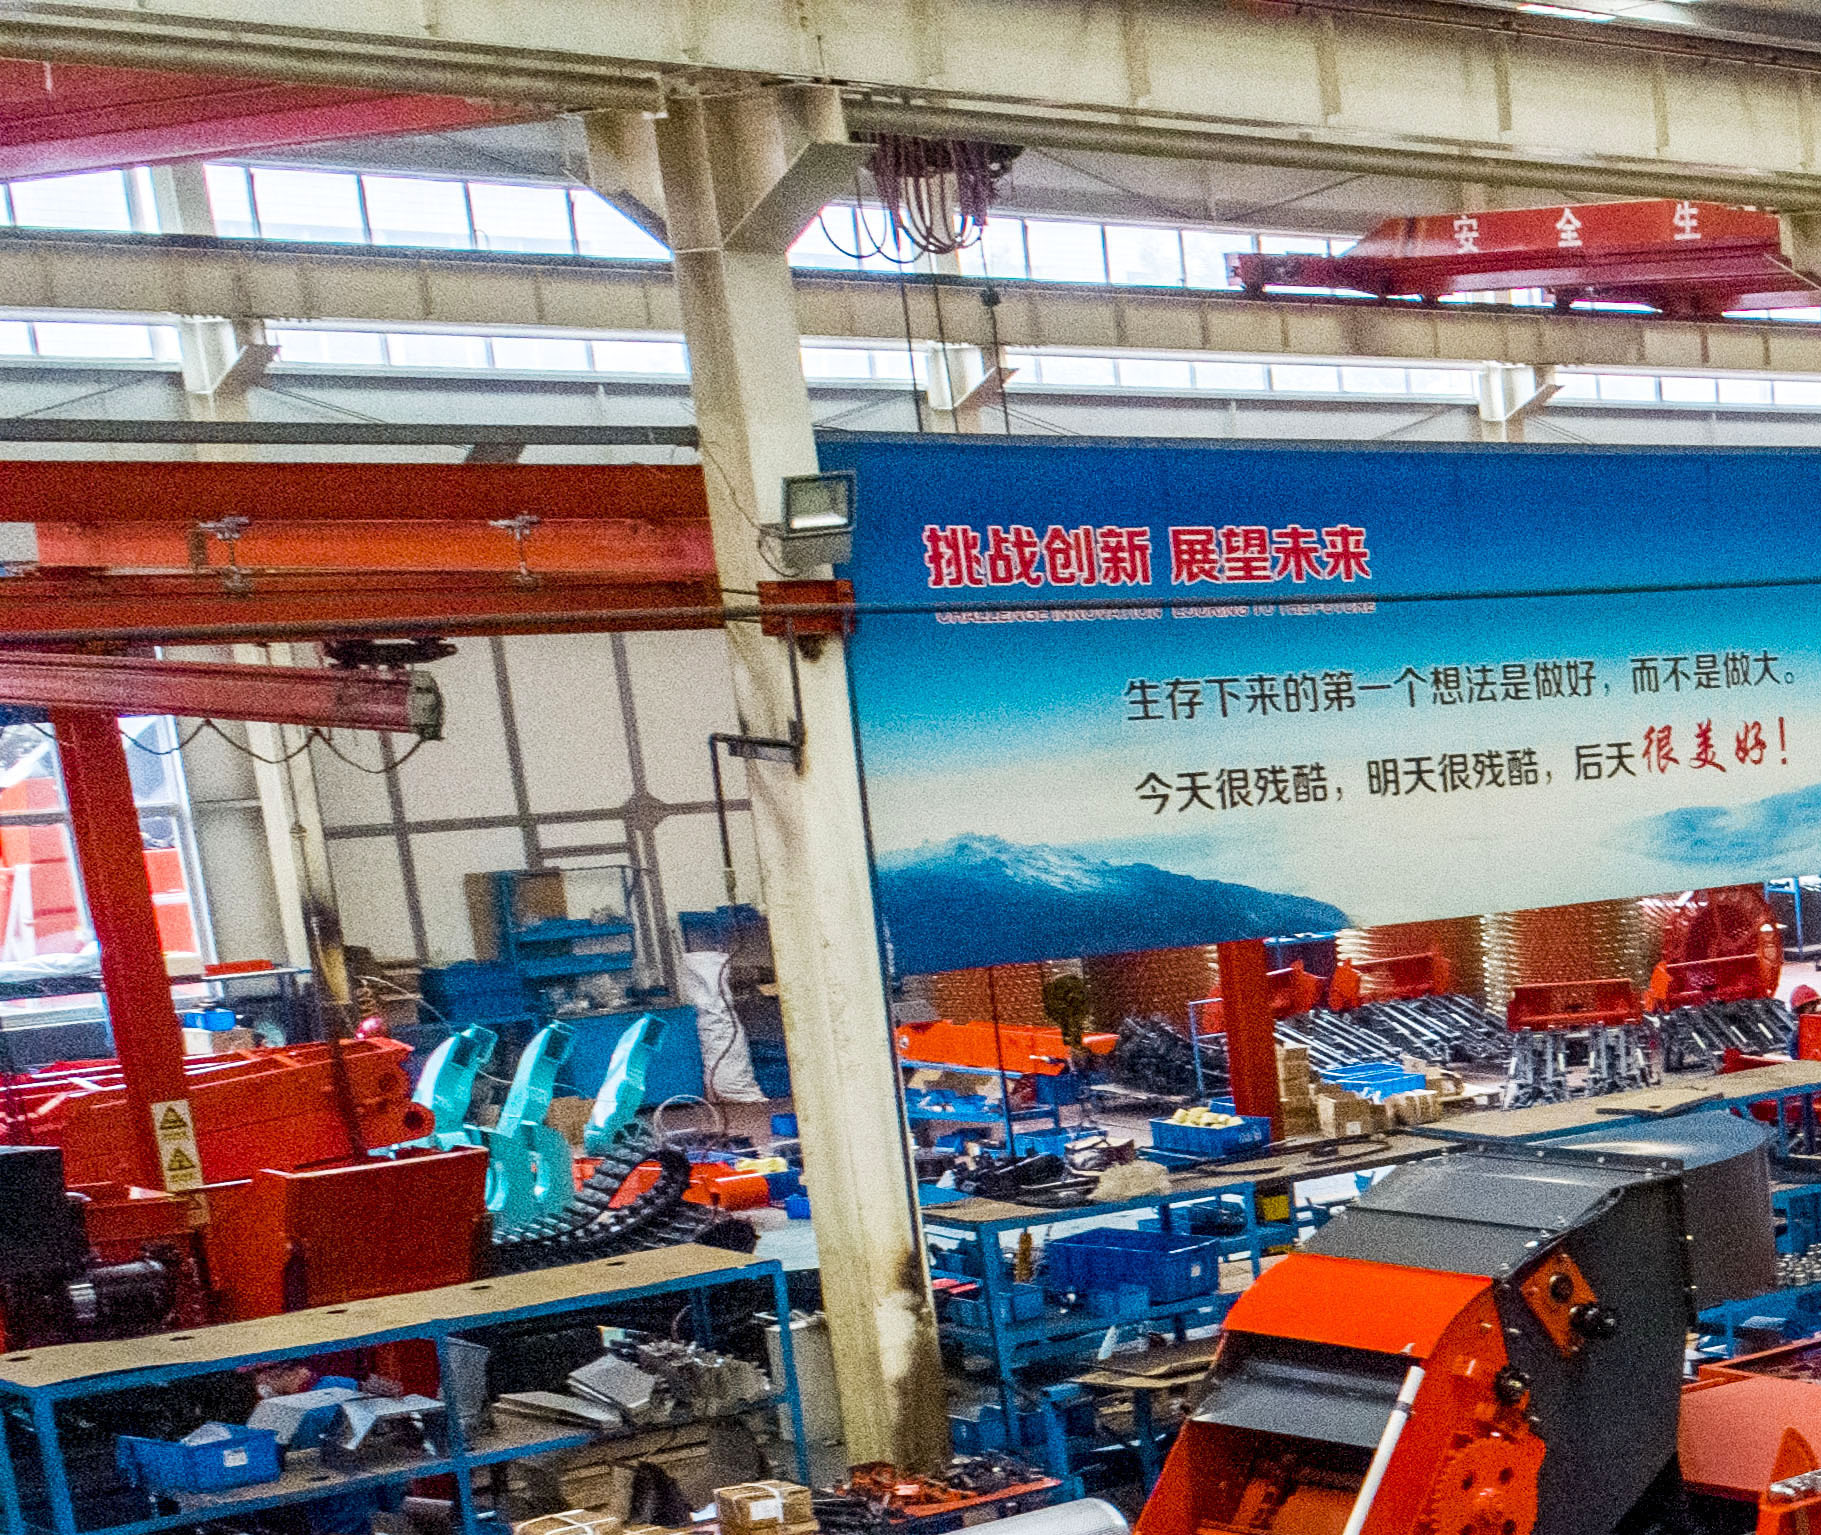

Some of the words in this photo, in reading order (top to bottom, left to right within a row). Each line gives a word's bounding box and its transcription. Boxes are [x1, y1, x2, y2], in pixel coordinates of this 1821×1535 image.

[1453, 200, 1702, 254] 安全生
[924, 524, 1154, 589] 挑战创新
[1167, 524, 1374, 586] 展望未来
[1124, 650, 1795, 723] 生存下来的第一个想法是做好，而不是做大。
